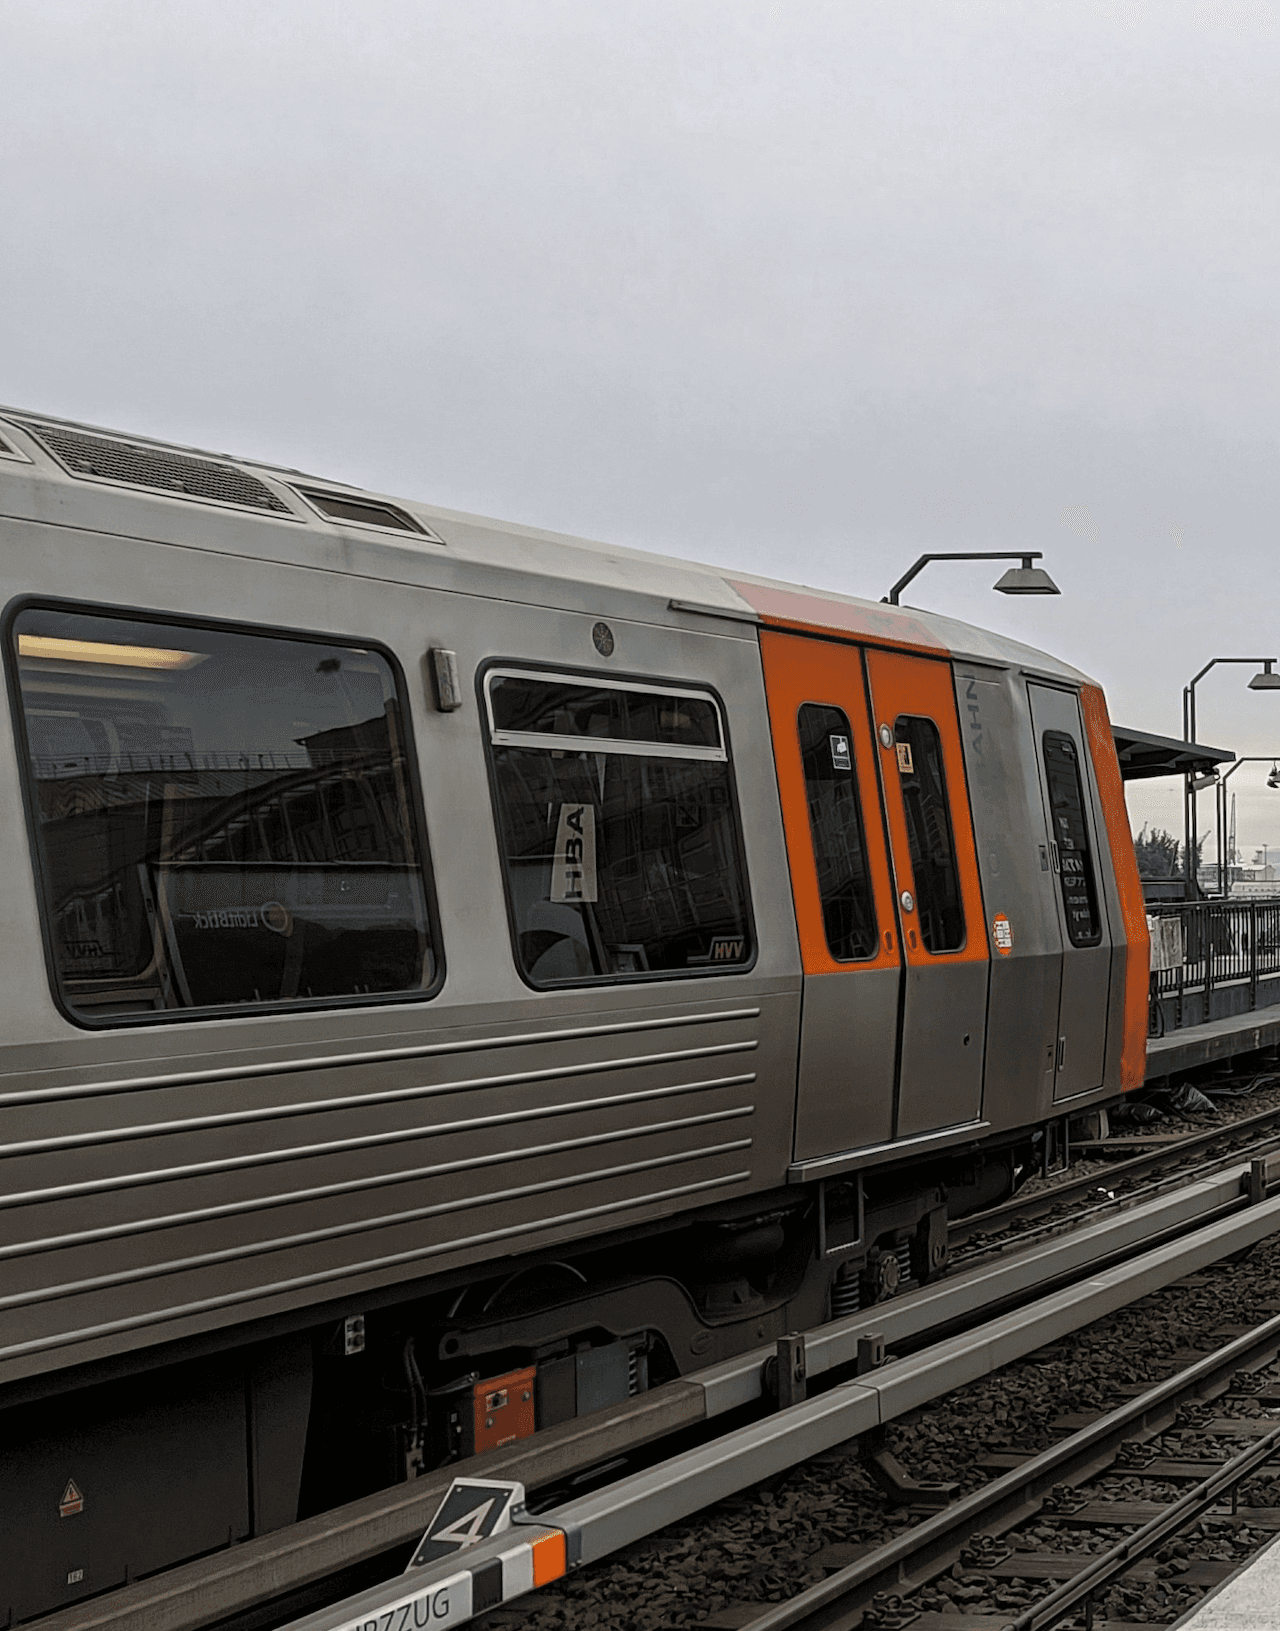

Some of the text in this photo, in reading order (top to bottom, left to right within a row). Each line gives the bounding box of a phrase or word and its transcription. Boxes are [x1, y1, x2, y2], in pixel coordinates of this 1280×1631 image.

[565, 806, 584, 899] HBA
[714, 941, 744, 960] HVV
[430, 1497, 496, 1551] 4
